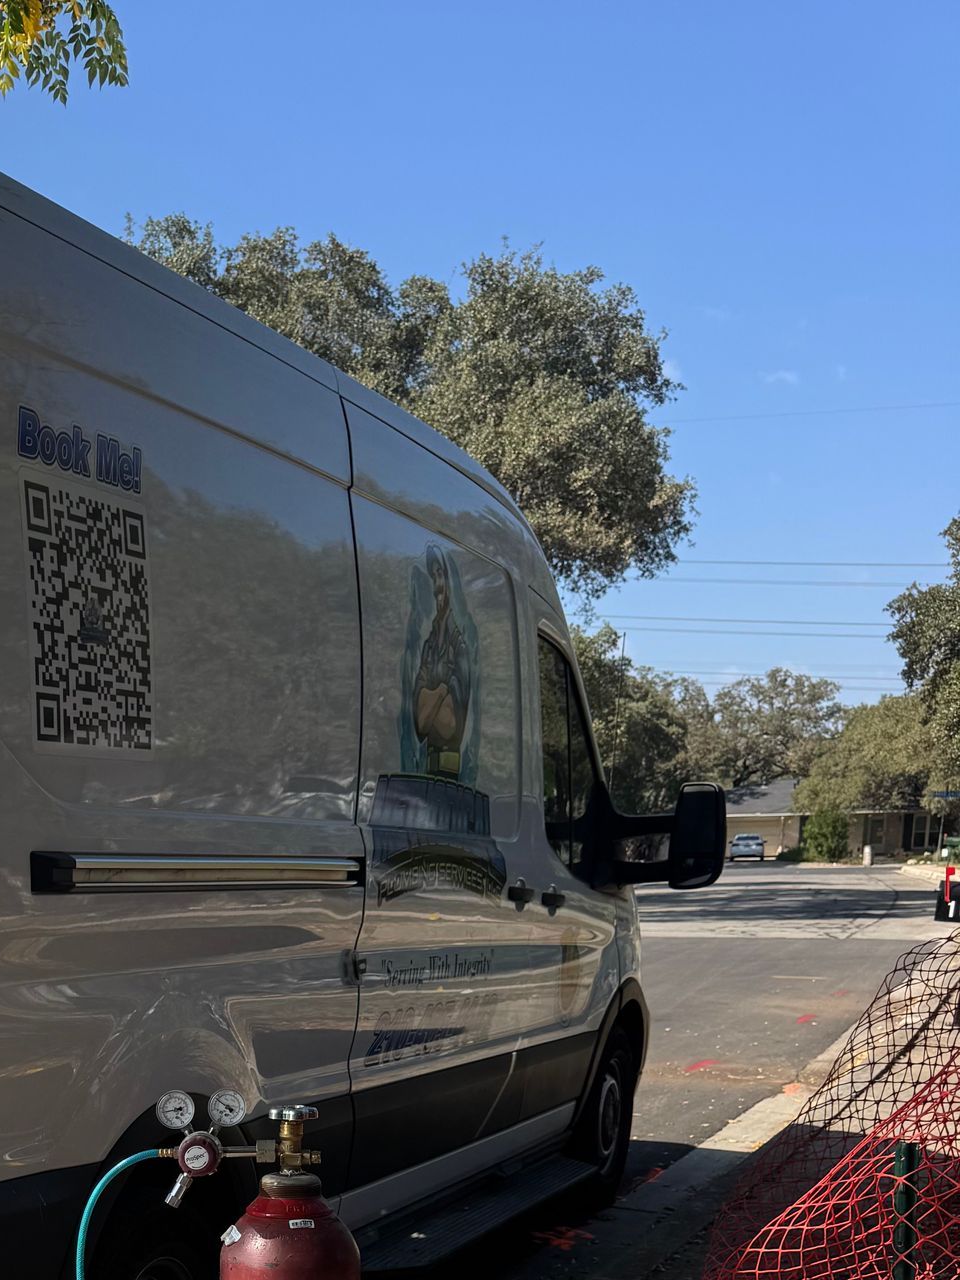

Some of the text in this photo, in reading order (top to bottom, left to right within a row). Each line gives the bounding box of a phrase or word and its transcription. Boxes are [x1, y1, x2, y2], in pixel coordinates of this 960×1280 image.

[18, 405, 142, 494] Book Me!
[429, 954, 450, 981] With
